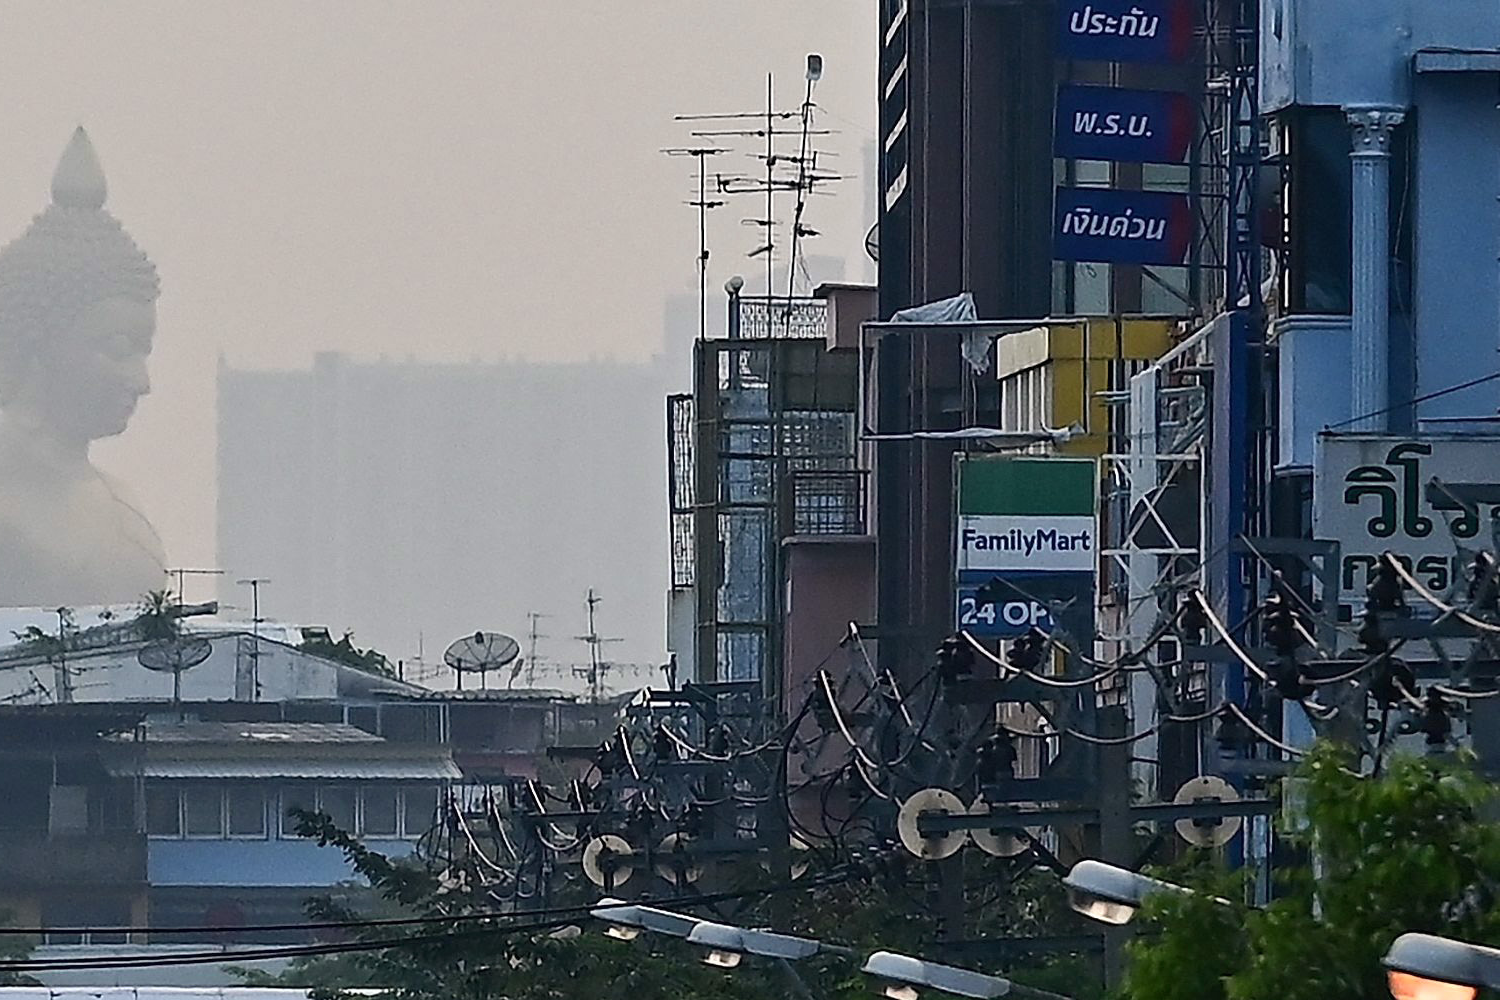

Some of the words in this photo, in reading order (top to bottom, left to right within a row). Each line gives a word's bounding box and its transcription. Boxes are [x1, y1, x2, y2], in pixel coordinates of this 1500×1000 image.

[1070, 6, 1159, 37] ประกัน
[1074, 112, 1153, 137] พ.ร.บ.
[1062, 208, 1166, 240] เงินด่วน
[962, 529, 1091, 557] FamilyMart
[961, 598, 996, 625] 24
[1003, 601, 1055, 626] OP
